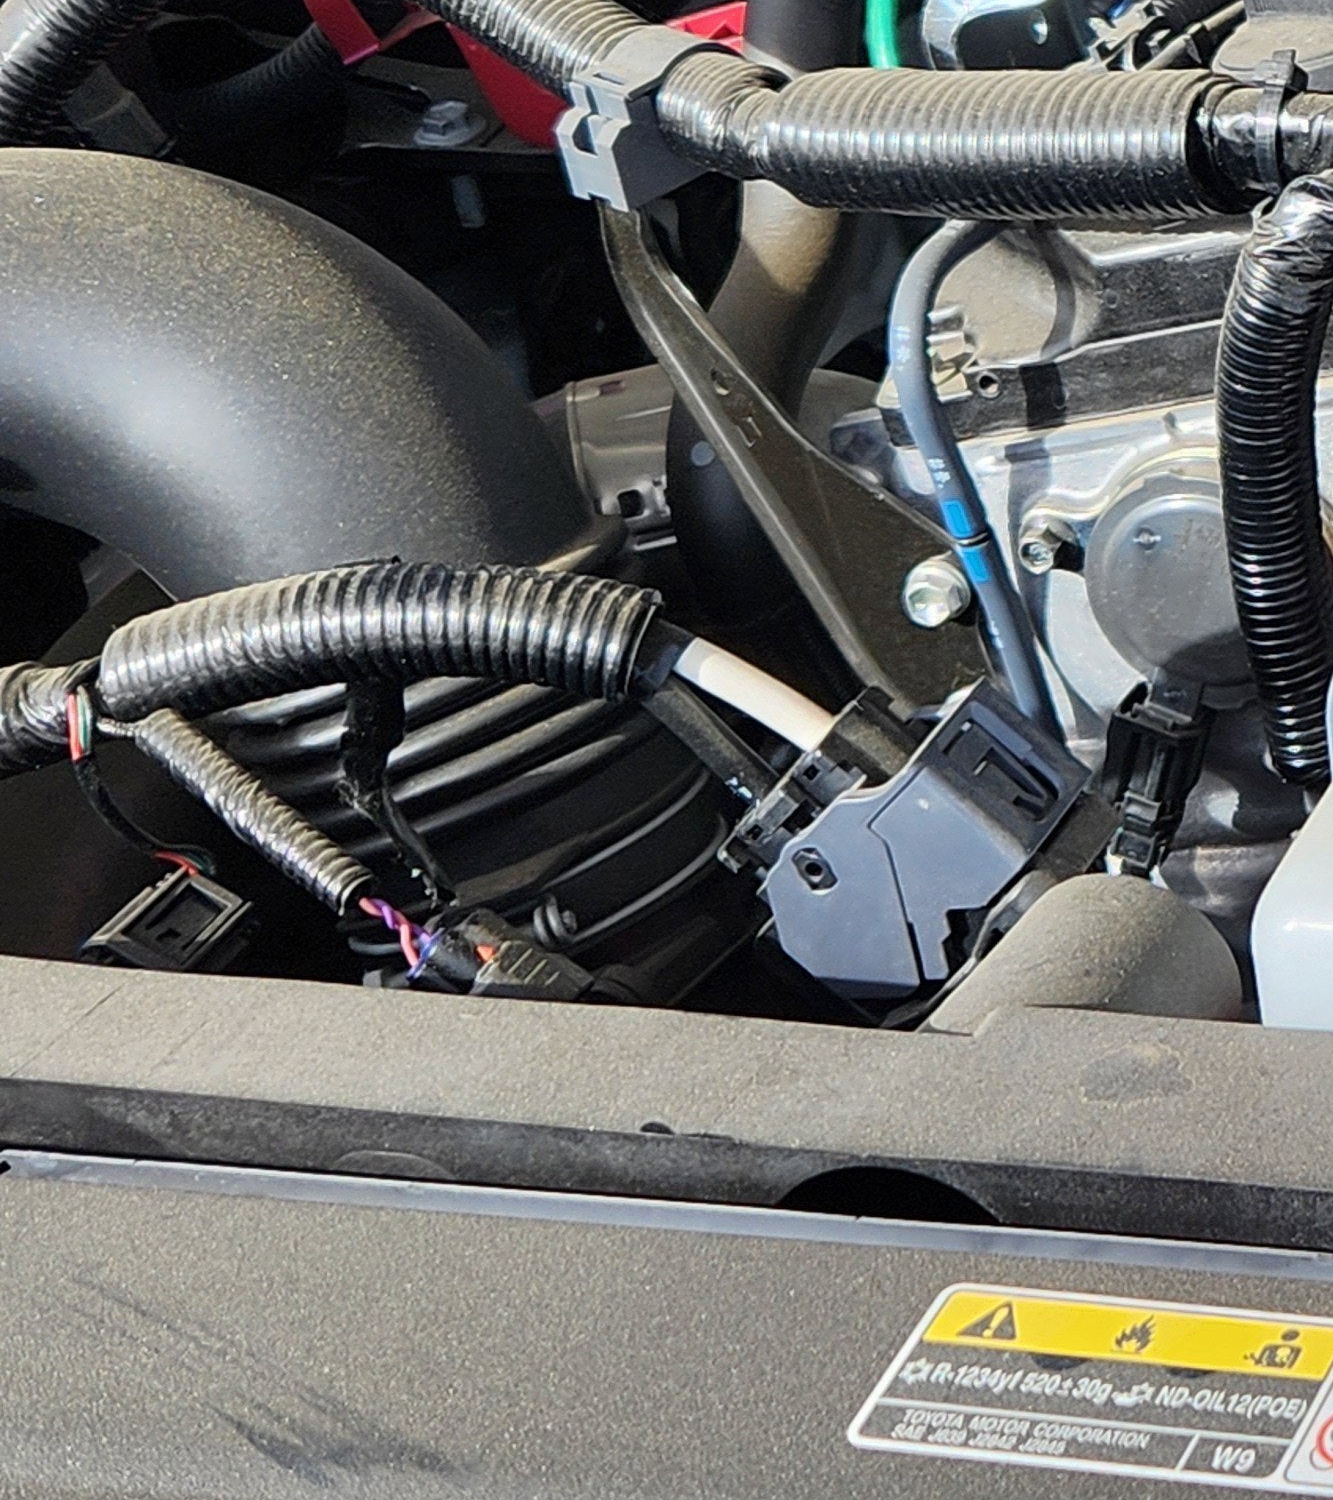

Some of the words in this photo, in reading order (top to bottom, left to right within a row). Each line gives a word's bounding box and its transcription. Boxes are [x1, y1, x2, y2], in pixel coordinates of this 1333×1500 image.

[929, 1361, 1024, 1395] R-1234yf
[1020, 1371, 1113, 1405] 520±30g
[1154, 1383, 1308, 1423] ND-OIL12(POE)
[890, 1423, 928, 1442] SAE
[902, 1408, 965, 1430] TOYOTA
[968, 1414, 1031, 1436] MOTOR
[1032, 1421, 1151, 1449] CORPORATION
[1210, 1444, 1257, 1474] W9
